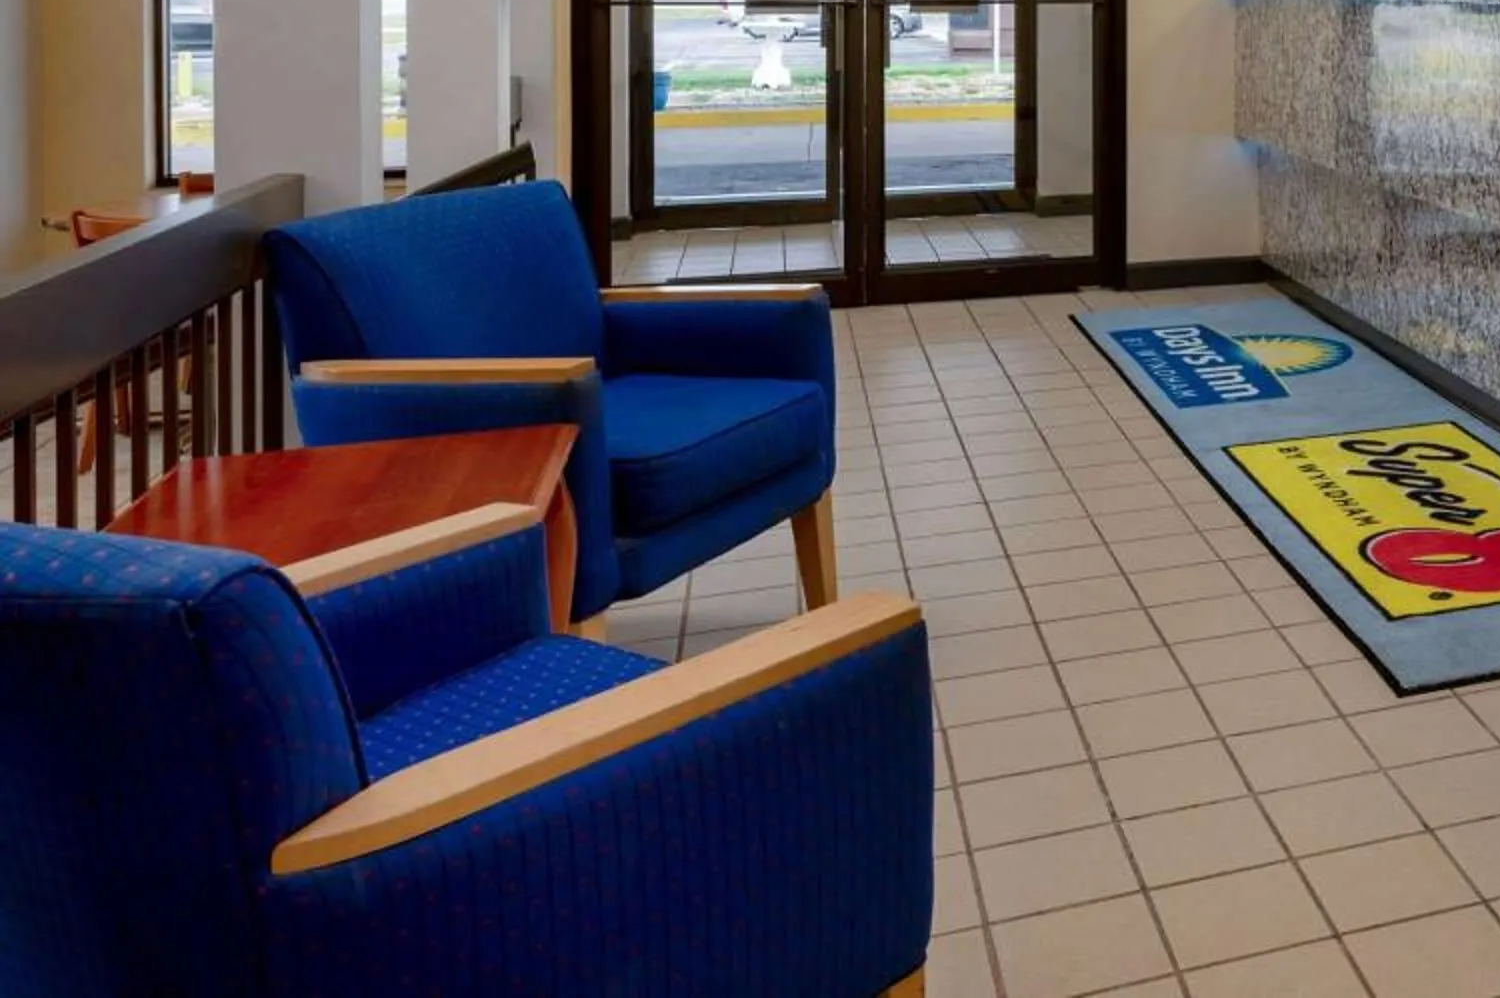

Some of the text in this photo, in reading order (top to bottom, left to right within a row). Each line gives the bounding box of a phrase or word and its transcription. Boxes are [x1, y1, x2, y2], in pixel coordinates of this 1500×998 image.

[1139, 350, 1199, 399] WYNDHAM
[1152, 326, 1262, 400] Days Inn
[1276, 445, 1382, 527] BY WYNDHAM
[1339, 438, 1490, 528] Super
